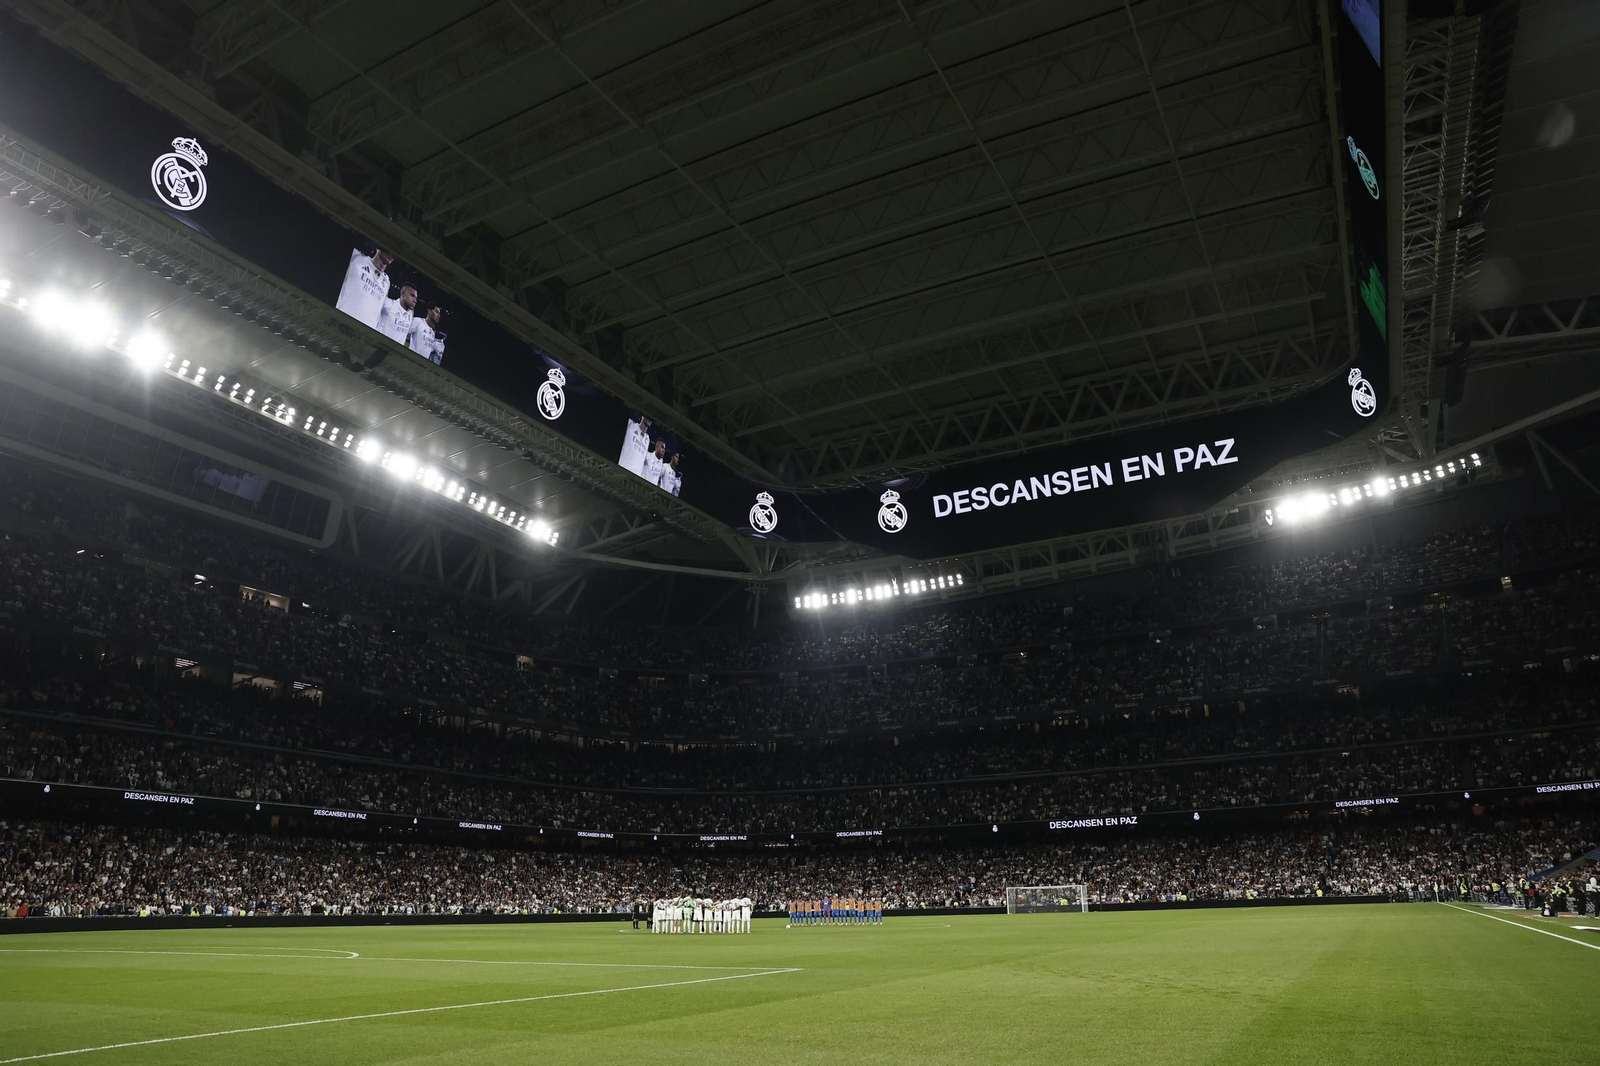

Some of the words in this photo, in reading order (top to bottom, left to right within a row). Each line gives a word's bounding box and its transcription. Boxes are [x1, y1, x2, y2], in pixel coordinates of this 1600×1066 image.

[932, 462, 1114, 518] DESCANSEN
[1121, 452, 1166, 483] EN
[1173, 438, 1239, 473] PAZ
[1583, 782, 1594, 790] EN
[124, 791, 169, 803] DESCANSEN
[169, 796, 180, 804] EN
[180, 797, 195, 805] PAZ
[1335, 798, 1375, 808] DESCANSEN
[313, 809, 348, 818] DESCANSEN
[1049, 818, 1104, 830] DESCANSEN
[1105, 817, 1119, 826] EN
[1120, 816, 1138, 826] PAZ
